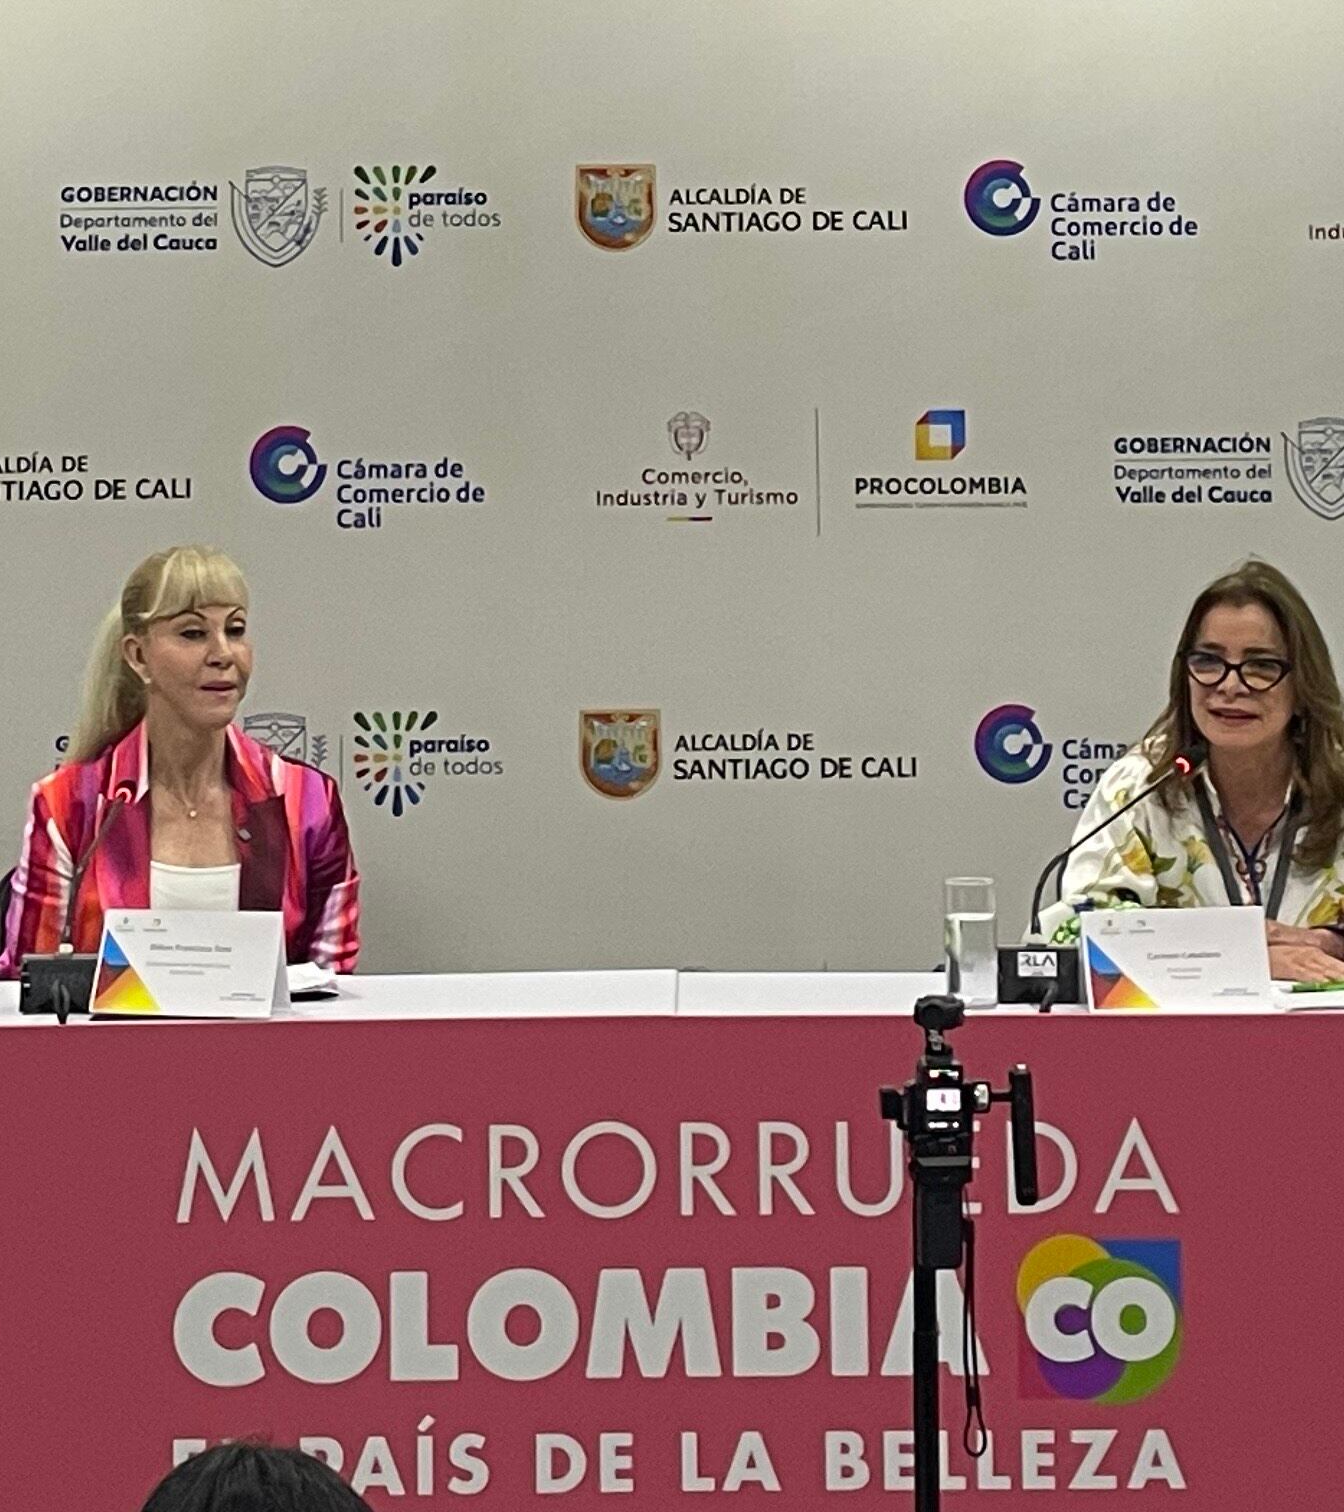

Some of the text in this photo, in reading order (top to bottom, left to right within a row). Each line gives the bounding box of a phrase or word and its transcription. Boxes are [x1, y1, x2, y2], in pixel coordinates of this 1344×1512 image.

[60, 180, 218, 203] GOBERNACIÓN
[408, 187, 488, 210] paraíso
[669, 184, 806, 206] ALCALDÍA DE
[1050, 190, 1176, 213] Cámara de
[59, 212, 218, 232] Departamento del
[668, 210, 908, 233] SANTIAGO DE CALI
[1050, 214, 1198, 237] Comercio de
[60, 233, 218, 252] Valle del Cauca
[1051, 239, 1096, 261] Cali
[1113, 432, 1271, 455] GOBERNACIÓN
[61, 454, 88, 473] DE
[336, 456, 464, 480] Cámara de
[641, 467, 749, 487] Comercio,
[855, 476, 1027, 495] PROCOLOMBIA
[94, 478, 127, 501] DE
[135, 477, 191, 500] CALI
[336, 480, 485, 504] Comercio de
[596, 488, 799, 509] Industria y Turismo
[1115, 484, 1273, 504] Valle del Cauca
[336, 506, 382, 529] Cali
[409, 733, 490, 759] paraíso
[674, 728, 815, 753] ALCALDÍA DE
[673, 756, 917, 781] SANTIAGO DE CALI
[173, 1266, 990, 1387] COLOMBIA
[1026, 1276, 1176, 1362] CO
[535, 1432, 635, 1494] DE
[681, 1431, 781, 1492] LA
[824, 1429, 1187, 1491] BELLEZA
